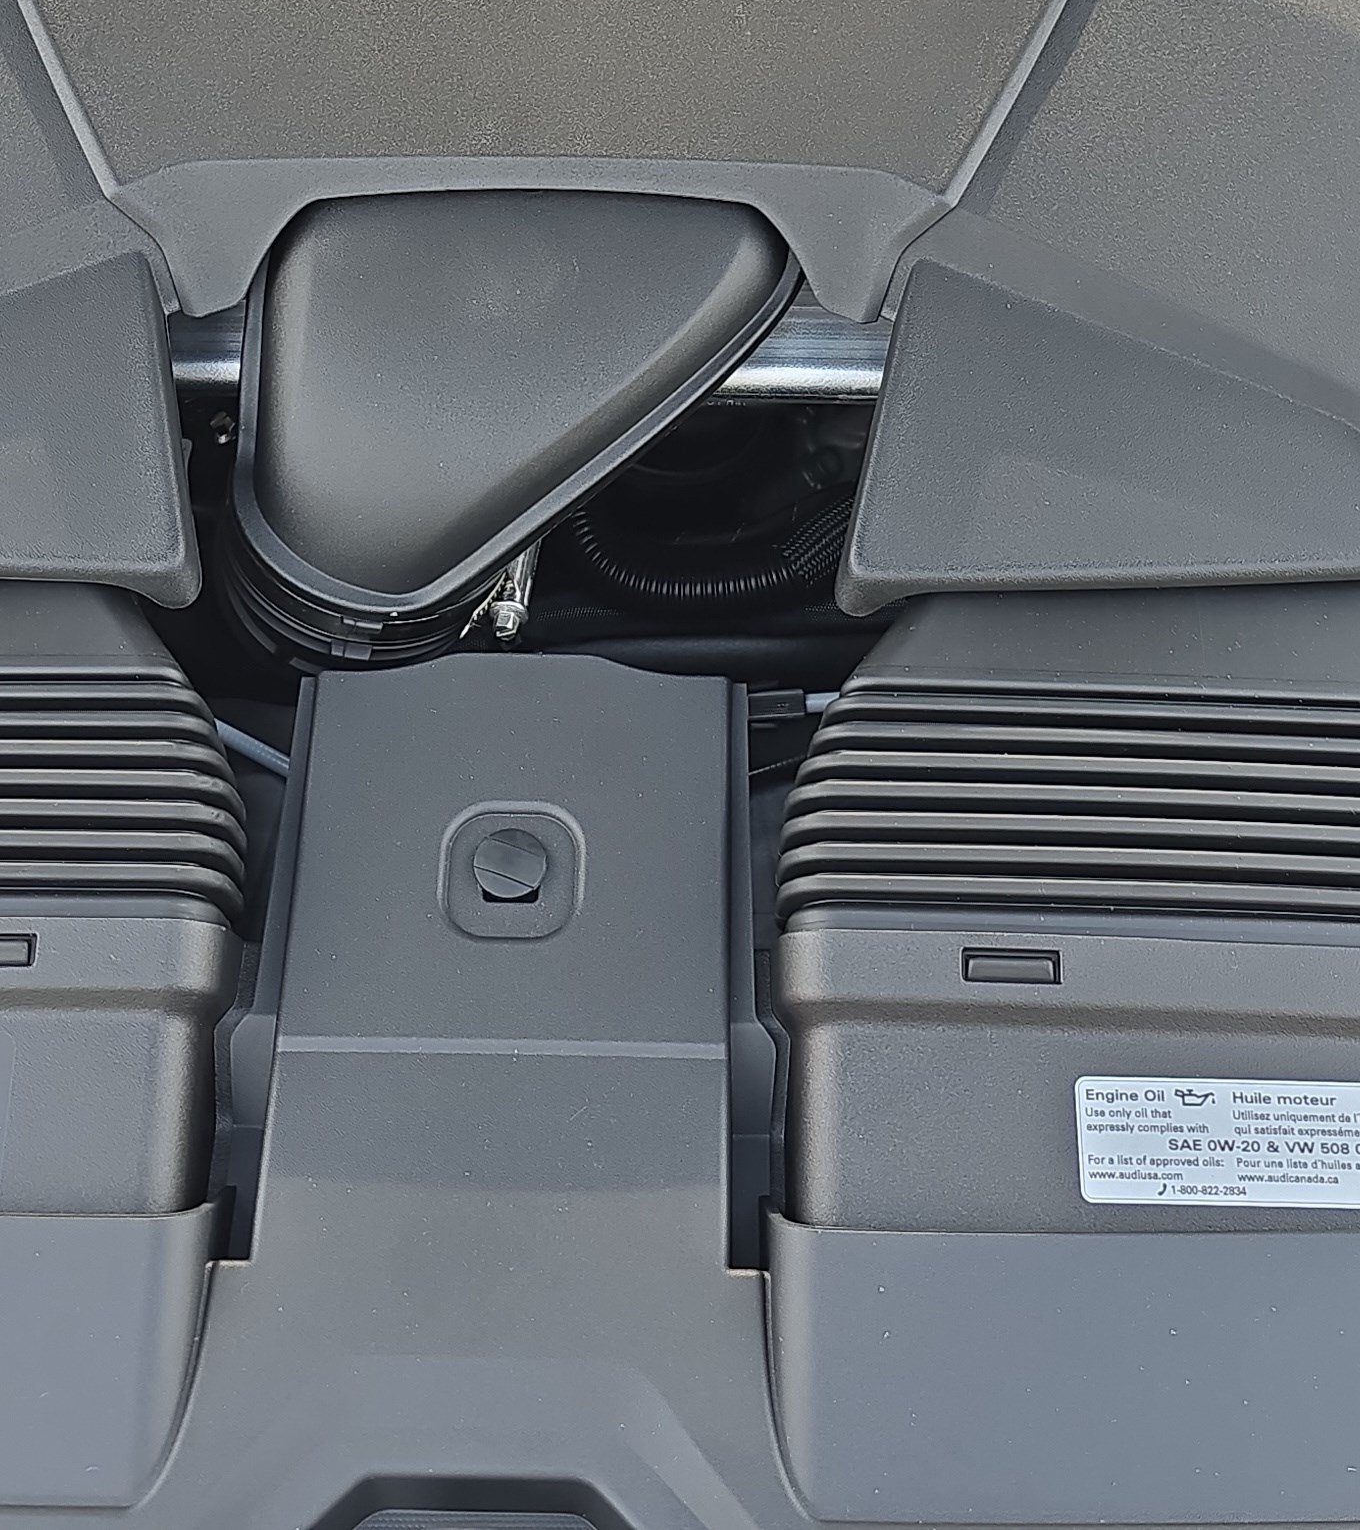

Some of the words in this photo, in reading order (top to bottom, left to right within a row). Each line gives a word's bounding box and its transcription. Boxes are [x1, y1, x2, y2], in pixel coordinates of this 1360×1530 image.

[1086, 1089, 1139, 1103] Engine
[1144, 1089, 1165, 1102] Oil
[1232, 1091, 1272, 1104] Huile
[1277, 1094, 1337, 1106] moteur
[1085, 1107, 1105, 1117] Use
[1109, 1108, 1132, 1119] only
[1135, 1107, 1148, 1118] oil
[1151, 1109, 1172, 1119] that
[1232, 1110, 1270, 1121] Utilisez
[1273, 1112, 1336, 1124] uniquement
[1338, 1113, 1350, 1123] de
[1086, 1122, 1135, 1134] expressly
[1137, 1123, 1184, 1135] complies
[1186, 1123, 1209, 1134] with
[1234, 1124, 1251, 1137] qui
[1254, 1125, 1296, 1136] satisfait
[1168, 1138, 1203, 1151] SAE
[1207, 1139, 1261, 1153] 0W-20
[1266, 1141, 1280, 1153] &
[1285, 1141, 1315, 1154] VW
[1320, 1143, 1350, 1155] 508
[1088, 1155, 1105, 1165] For
[1108, 1157, 1114, 1165] a
[1117, 1155, 1133, 1165] list
[1136, 1155, 1147, 1166] of
[1149, 1156, 1199, 1168] approved
[1202, 1157, 1224, 1167] oils:
[1236, 1158, 1261, 1168] Pour
[1263, 1160, 1284, 1168] une
[1286, 1159, 1308, 1169] liste
[1311, 1159, 1352, 1170] d'huiles
[1088, 1170, 1183, 1180] www.audiusa.com
[1237, 1173, 1339, 1184] www.audicanada.ca
[1171, 1185, 1247, 1196] 1-800-822-2834
